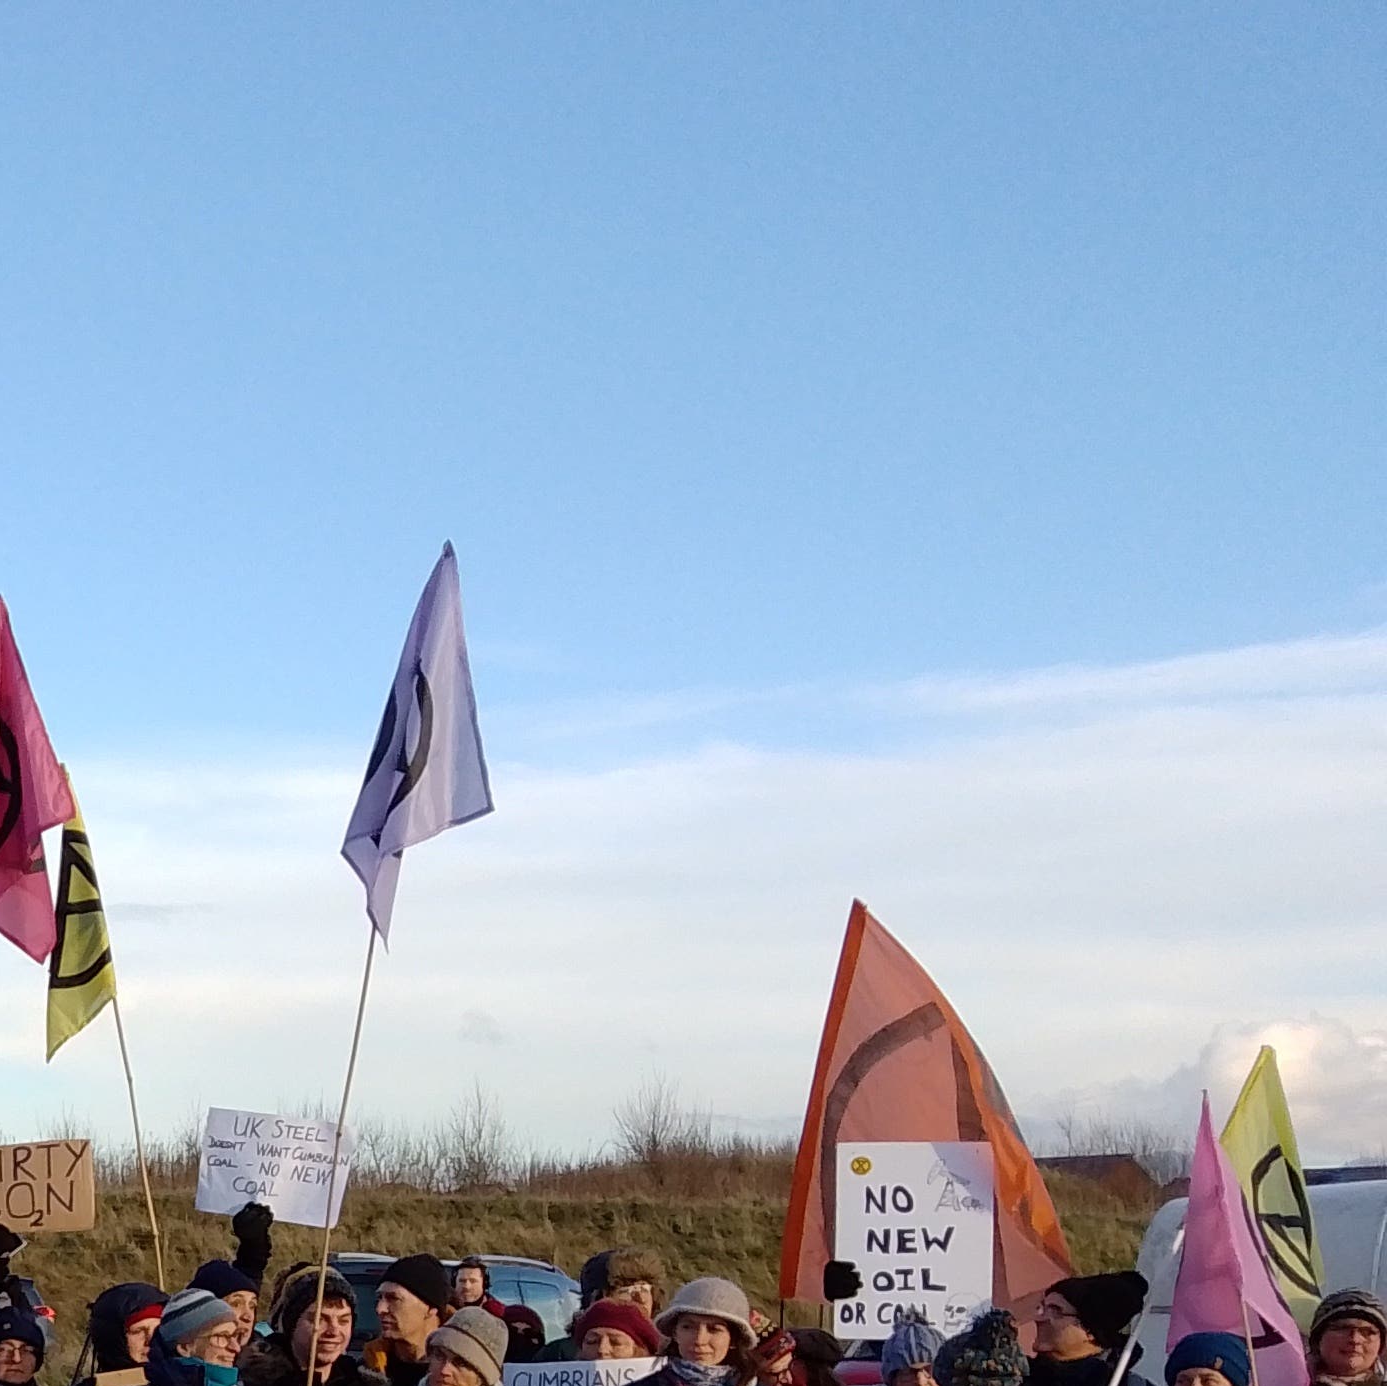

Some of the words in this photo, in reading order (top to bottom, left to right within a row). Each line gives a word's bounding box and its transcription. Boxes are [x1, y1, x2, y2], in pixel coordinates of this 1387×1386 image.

[233, 1116, 265, 1139] UK
[271, 1120, 327, 1143] STEEL
[256, 1142, 292, 1160] WANT
[207, 1155, 238, 1169] COAL
[259, 1161, 280, 1177] NO
[290, 1165, 334, 1186] NEW
[232, 1176, 279, 1197] COAL
[865, 1185, 914, 1214] NO
[867, 1226, 955, 1254] NEW
[872, 1268, 946, 1292] OIL
[840, 1302, 867, 1325] OR
